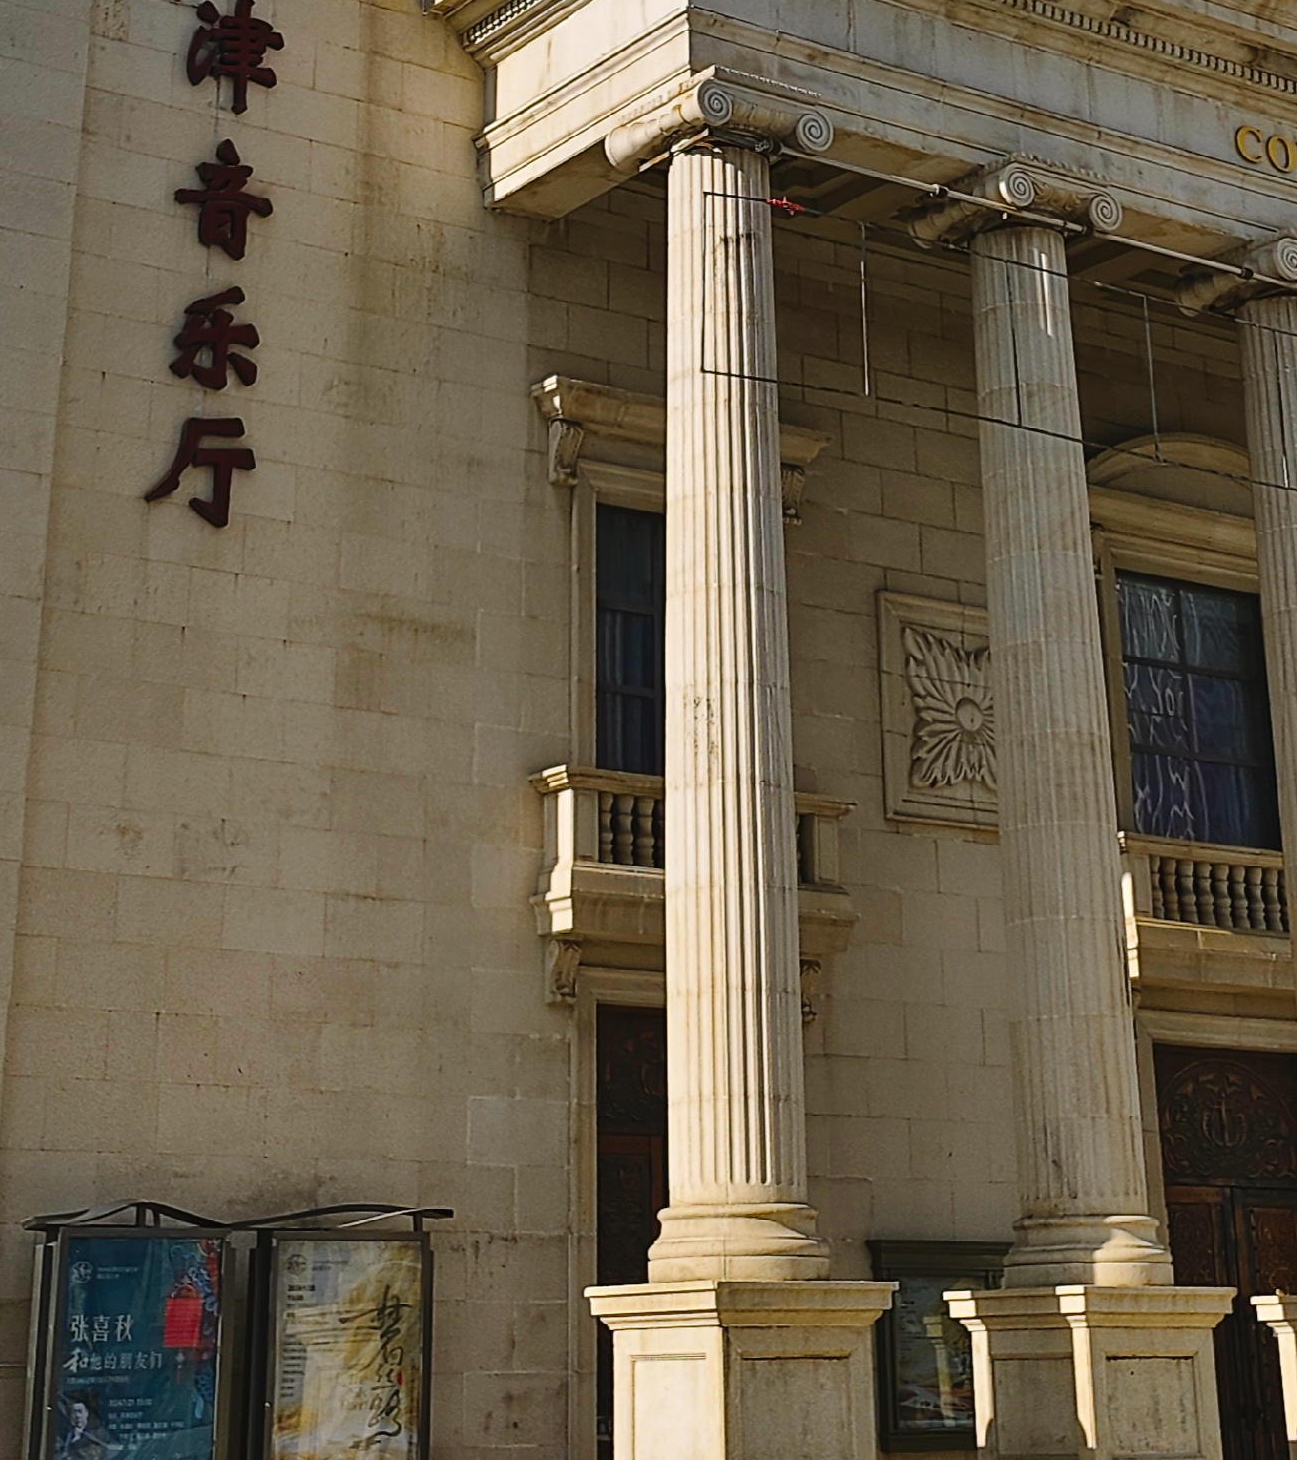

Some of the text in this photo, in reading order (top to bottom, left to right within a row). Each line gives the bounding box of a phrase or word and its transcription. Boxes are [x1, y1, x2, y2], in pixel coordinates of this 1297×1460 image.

[70, 1314, 133, 1342] 张喜秋
[63, 1347, 162, 1373] 和他的朋友们
